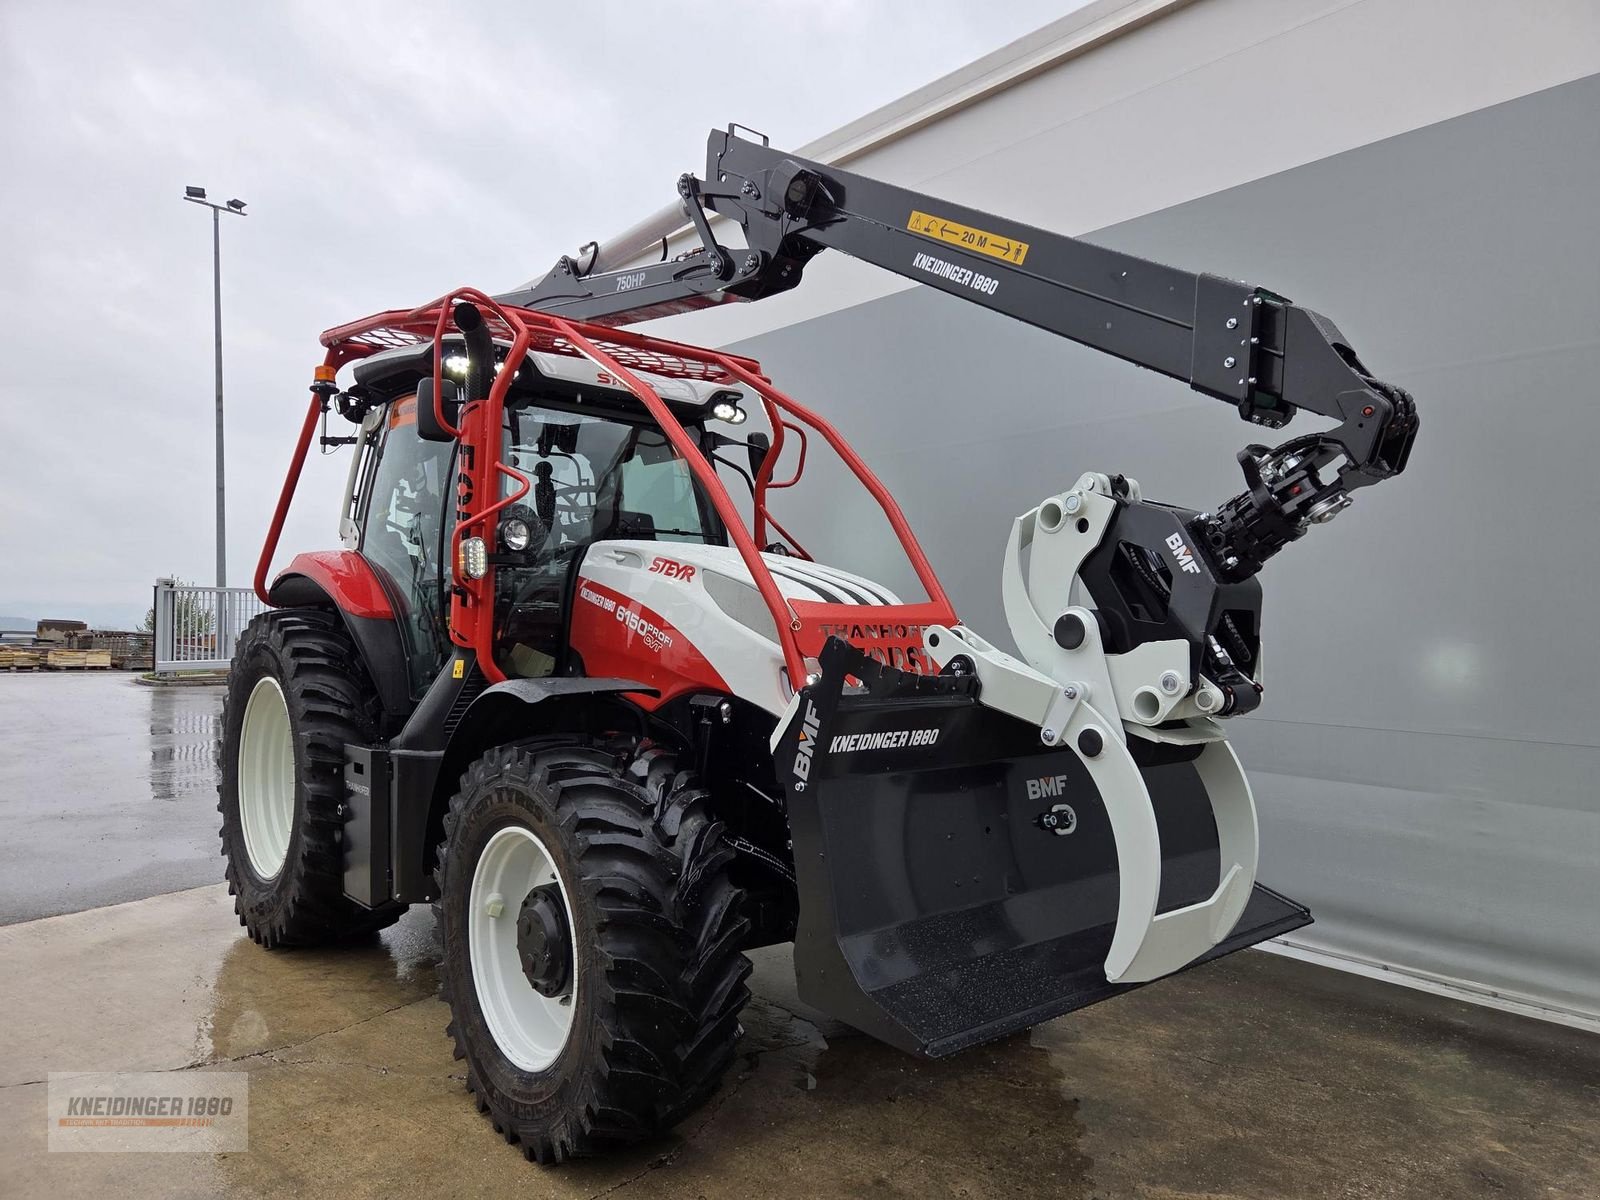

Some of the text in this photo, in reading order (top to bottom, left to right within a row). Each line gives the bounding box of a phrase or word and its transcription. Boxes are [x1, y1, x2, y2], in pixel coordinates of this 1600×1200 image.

[961, 230, 989, 248] 20 M
[616, 271, 646, 292] 750HP
[912, 252, 999, 296] KNEIDINGER 1880
[1165, 532, 1201, 574] BMF
[648, 556, 696, 583] STEYR
[616, 605, 673, 648] 6150 PROFI
[793, 699, 821, 782] BMF
[828, 728, 940, 753] KNEIDINGER 1880
[1026, 775, 1067, 800] BMF
